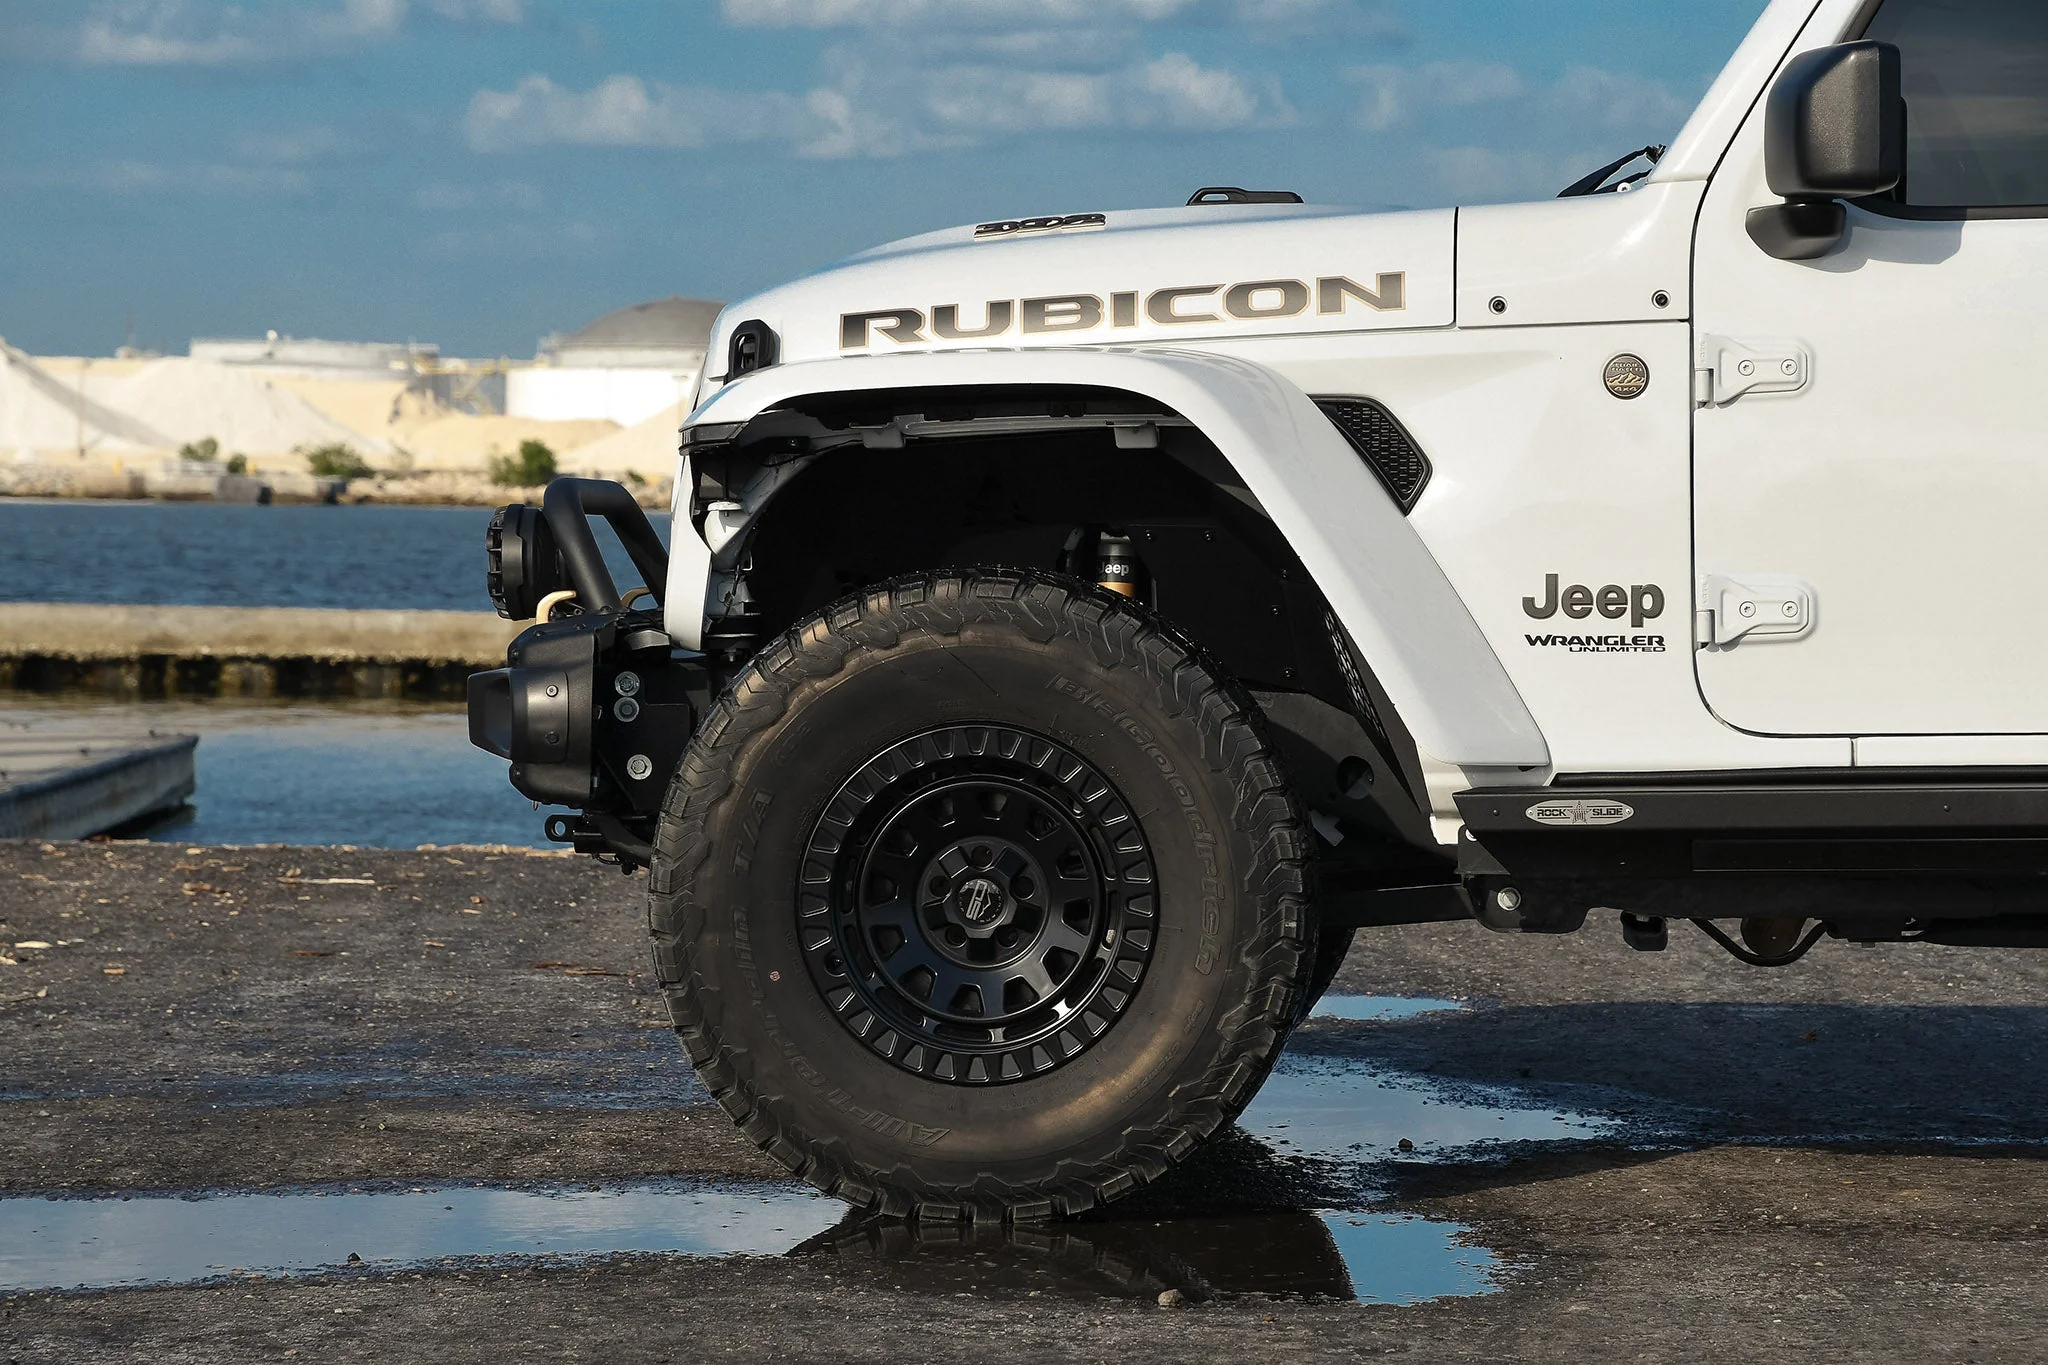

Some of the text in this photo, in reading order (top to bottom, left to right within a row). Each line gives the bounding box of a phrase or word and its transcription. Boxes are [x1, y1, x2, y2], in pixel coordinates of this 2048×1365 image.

[839, 271, 1406, 350] RUBICON
[1099, 562, 1130, 576] Jeep
[1522, 573, 1666, 628] Jeep
[1524, 634, 1666, 646] WRANGLER
[1537, 807, 1623, 817] ROCK SLIDE
